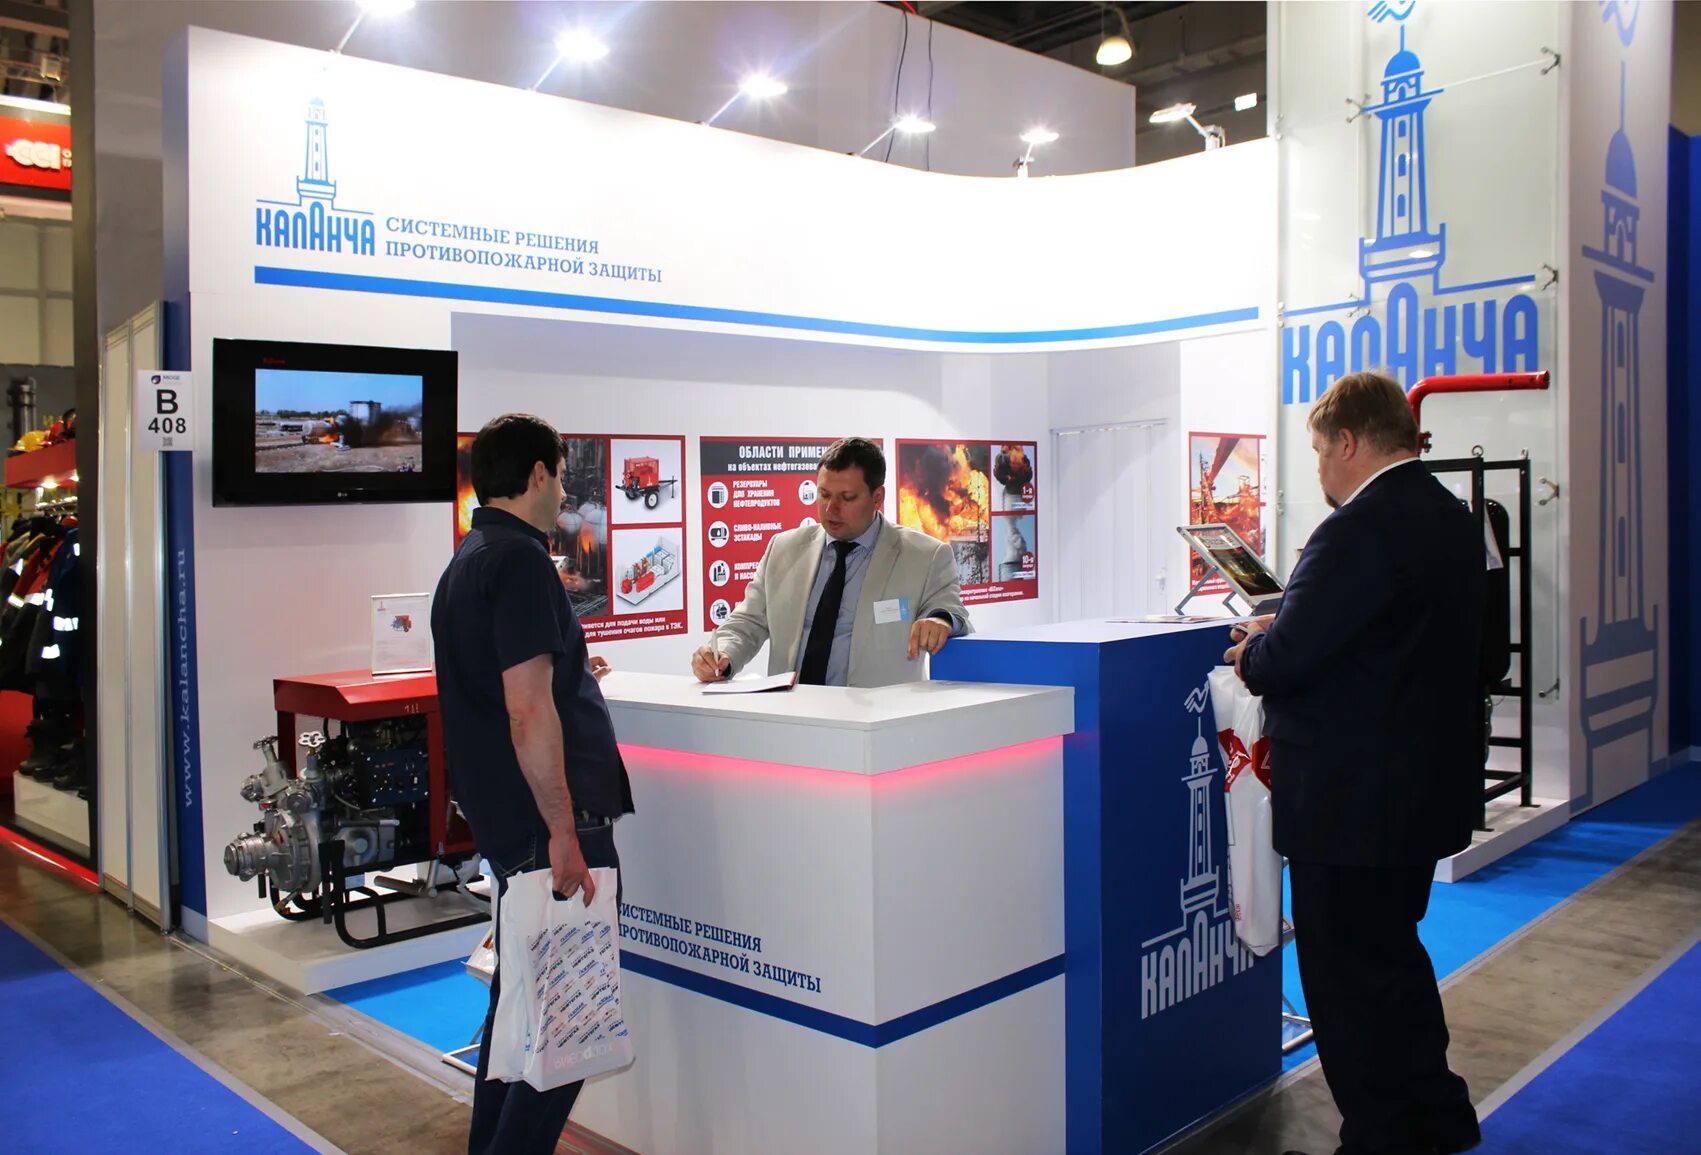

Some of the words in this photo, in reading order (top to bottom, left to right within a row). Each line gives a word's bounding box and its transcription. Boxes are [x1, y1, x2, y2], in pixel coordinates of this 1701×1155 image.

[256, 201, 375, 256] КАЛАНЧА
[386, 216, 511, 245] СИСТЕМНЫЕ
[515, 231, 599, 255] РЕШЕНИЯ
[386, 240, 584, 275] ПРОТИВОПОЖАРНОЙ
[589, 262, 662, 283] ЗАЩИТЫ
[156, 389, 178, 415] B
[148, 417, 186, 434] 408
[727, 463, 736, 471] на
[738, 462, 771, 472] объектах
[739, 446, 784, 459] ОБЛАСТИ
[178, 549, 192, 807] www.kalancha.ru
[619, 902, 692, 935] ИСТЕМНЫЕ
[695, 921, 762, 953] РЕШЕНИЯ
[753, 960, 821, 993] ЗАЩИТЫ
